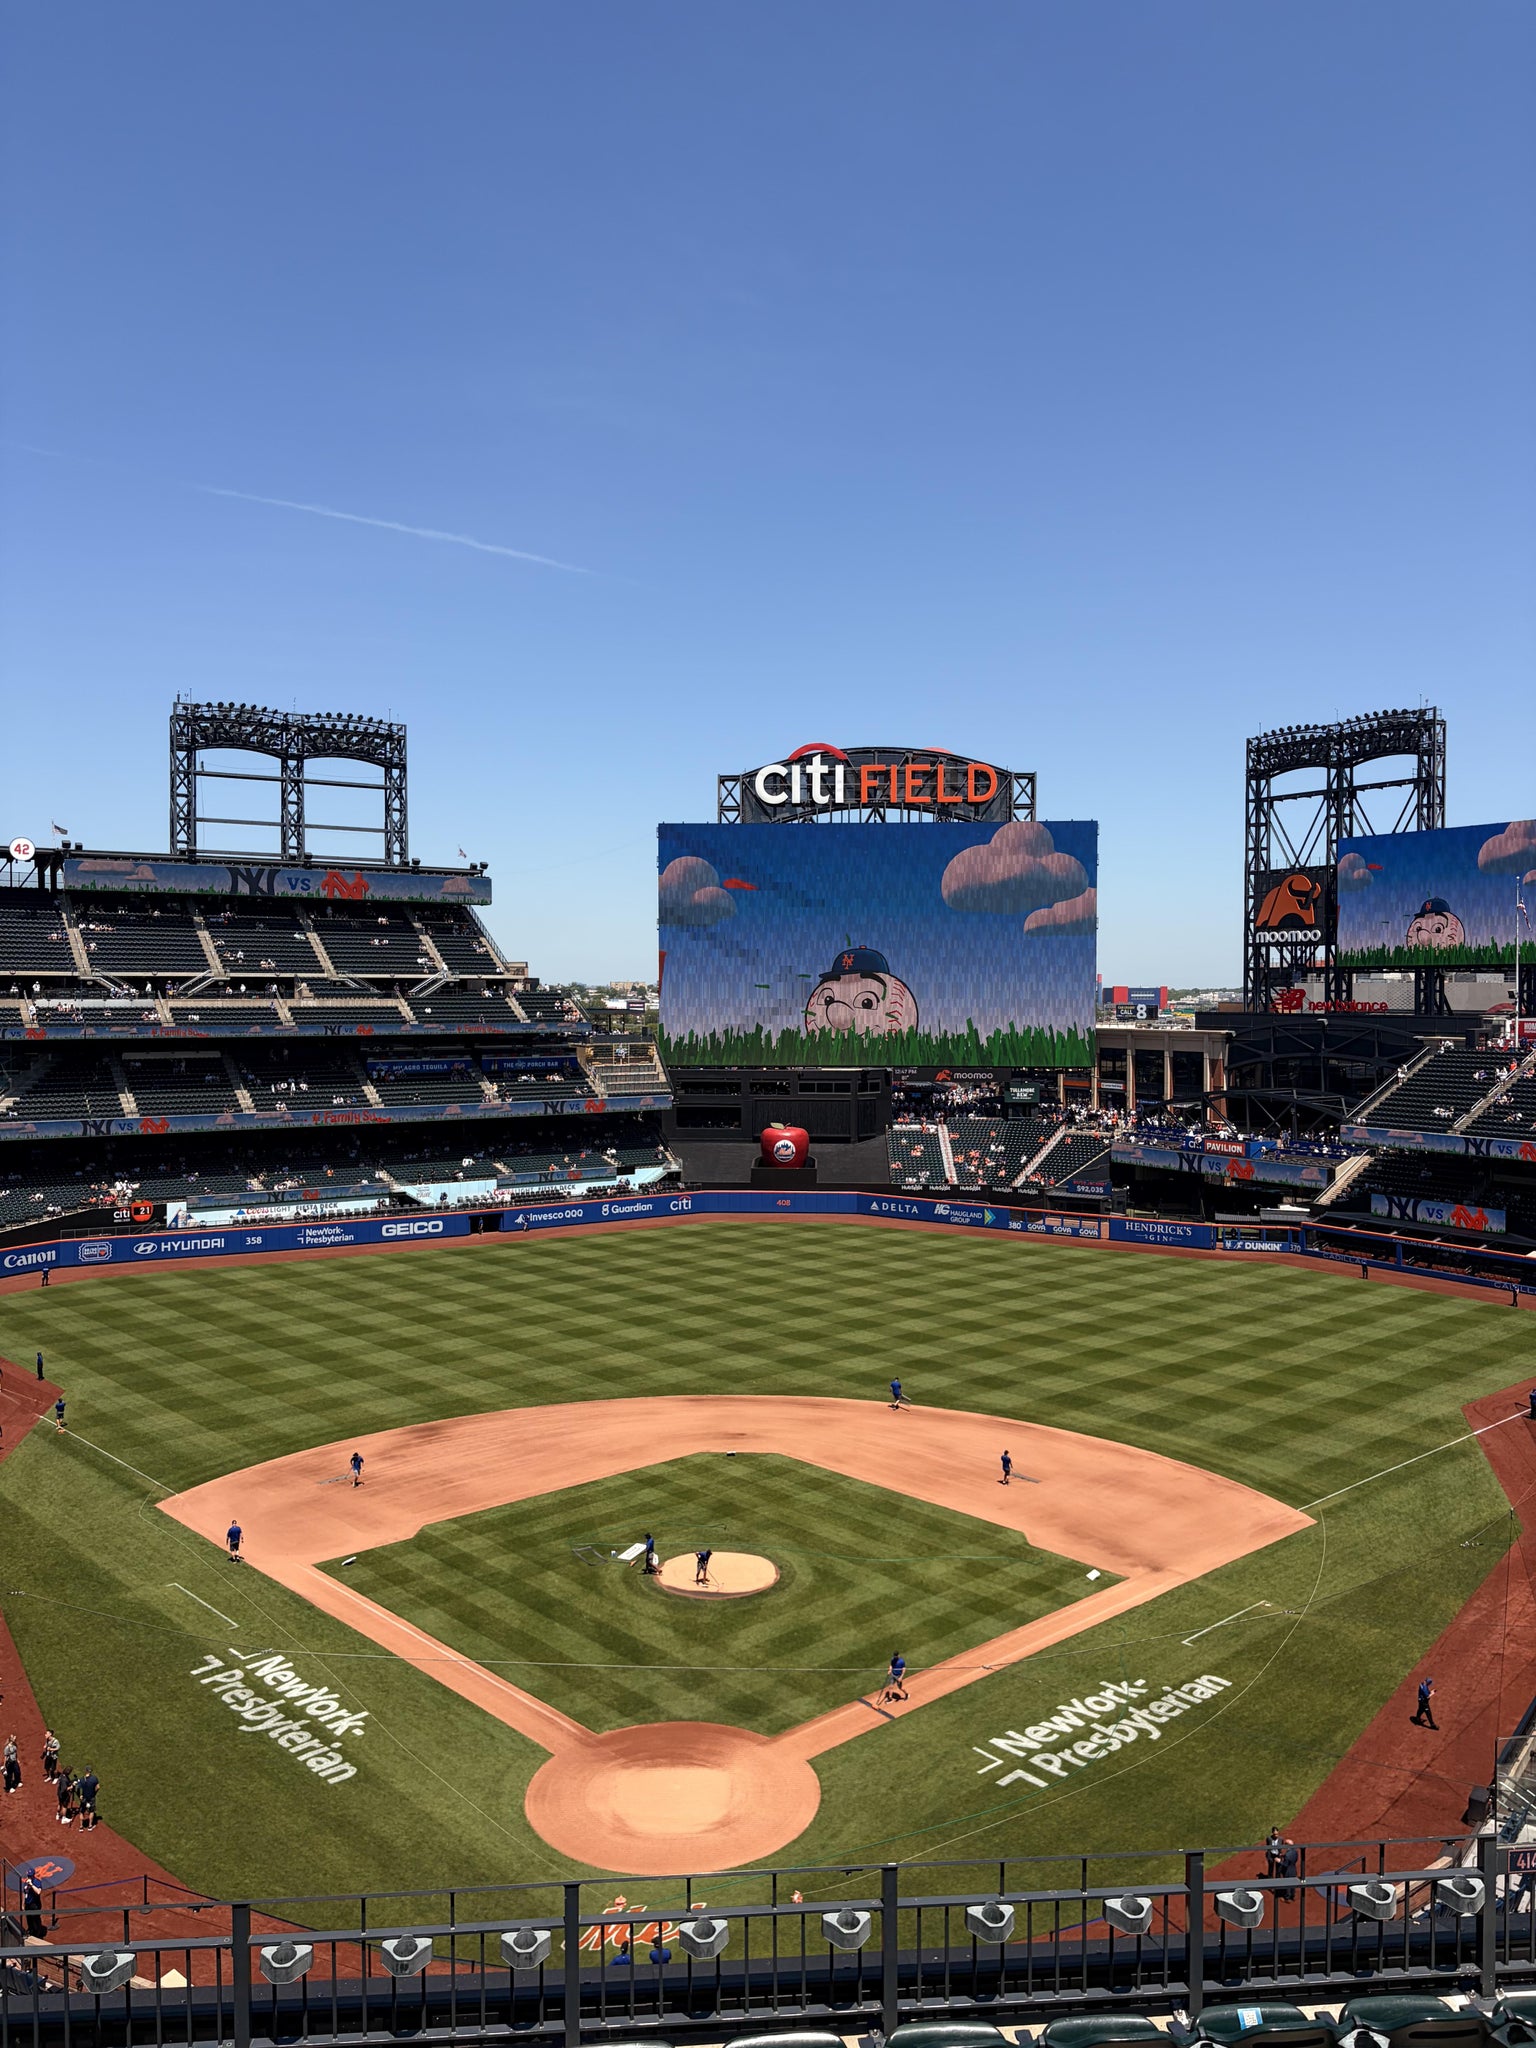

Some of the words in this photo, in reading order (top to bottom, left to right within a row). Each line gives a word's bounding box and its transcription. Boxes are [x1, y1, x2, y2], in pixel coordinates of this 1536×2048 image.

[755, 753, 844, 804] citi
[860, 763, 997, 803] FIELD
[14, 843, 30, 855] 42
[287, 877, 311, 891] VS
[1255, 929, 1321, 943] moomoo
[1137, 1004, 1147, 1019] 8
[1308, 1001, 1332, 1011] new
[1336, 1000, 1388, 1012] balance
[954, 1072, 994, 1080] moomoo
[118, 1122, 134, 1131] VS
[1207, 1142, 1243, 1154] PAVILION
[1498, 1145, 1513, 1155] VS
[1208, 1161, 1222, 1172] VS
[1077, 1185, 1104, 1194] $92,035
[612, 1203, 653, 1214] Guardian
[670, 1198, 692, 1211] citi
[882, 1203, 919, 1214] DELTA
[113, 1209, 131, 1219] citi
[140, 1207, 150, 1215] 21
[530, 1212, 563, 1222] Invesco
[565, 1209, 584, 1219] QQQ
[950, 1210, 983, 1219] HAUGLAND
[1426, 1207, 1444, 1220] VS
[950, 1216, 971, 1224] GROUP
[1008, 1221, 1022, 1230] 380
[382, 1221, 444, 1237] GEICO
[1027, 1223, 1047, 1232] GOYA
[1053, 1226, 1072, 1235] GOYA
[1079, 1228, 1099, 1237] GOYA
[1125, 1222, 1192, 1236] HENDRICK'S
[161, 1238, 225, 1252] HYUNDAI
[246, 1237, 263, 1245] 358
[305, 1234, 355, 1245] Presbyterian
[1245, 1242, 1282, 1251] DUNKIN'
[4, 1250, 57, 1269] Canon
[200, 1669, 358, 1785] Presbyterian
[1029, 1674, 1233, 1778] Presbyterian
